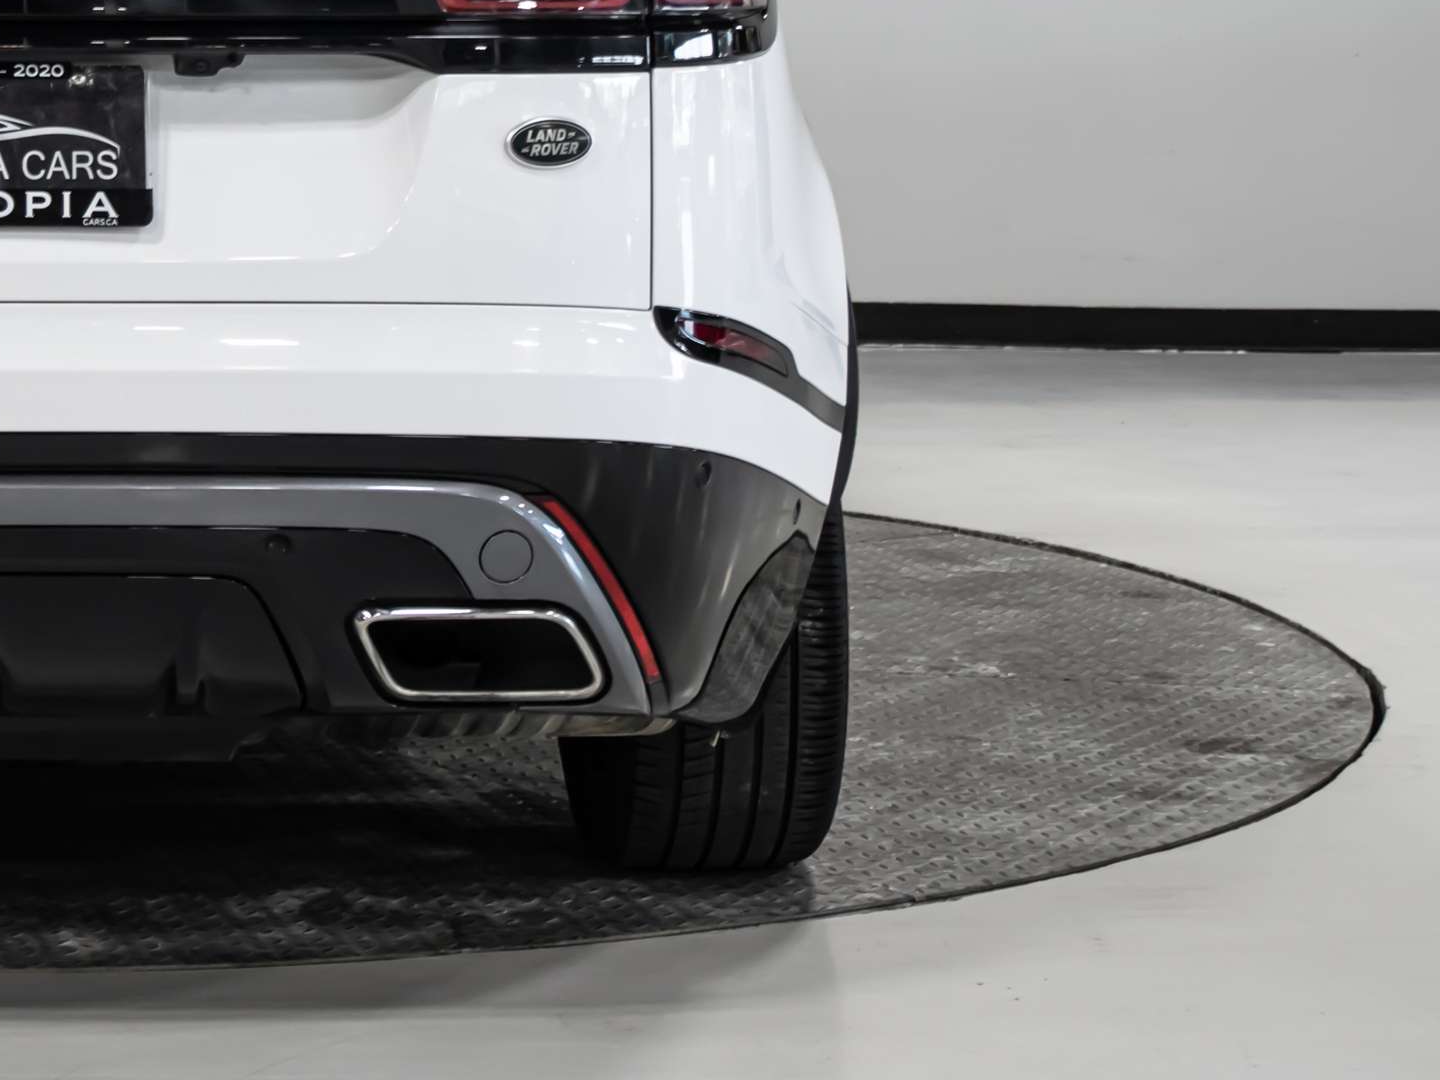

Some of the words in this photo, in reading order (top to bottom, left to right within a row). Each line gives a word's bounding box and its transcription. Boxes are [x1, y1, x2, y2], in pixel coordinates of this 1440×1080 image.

[13, 63, 64, 78] 2020
[526, 128, 566, 143] LAND
[529, 141, 579, 157] ROVER
[22, 150, 119, 180] CARS
